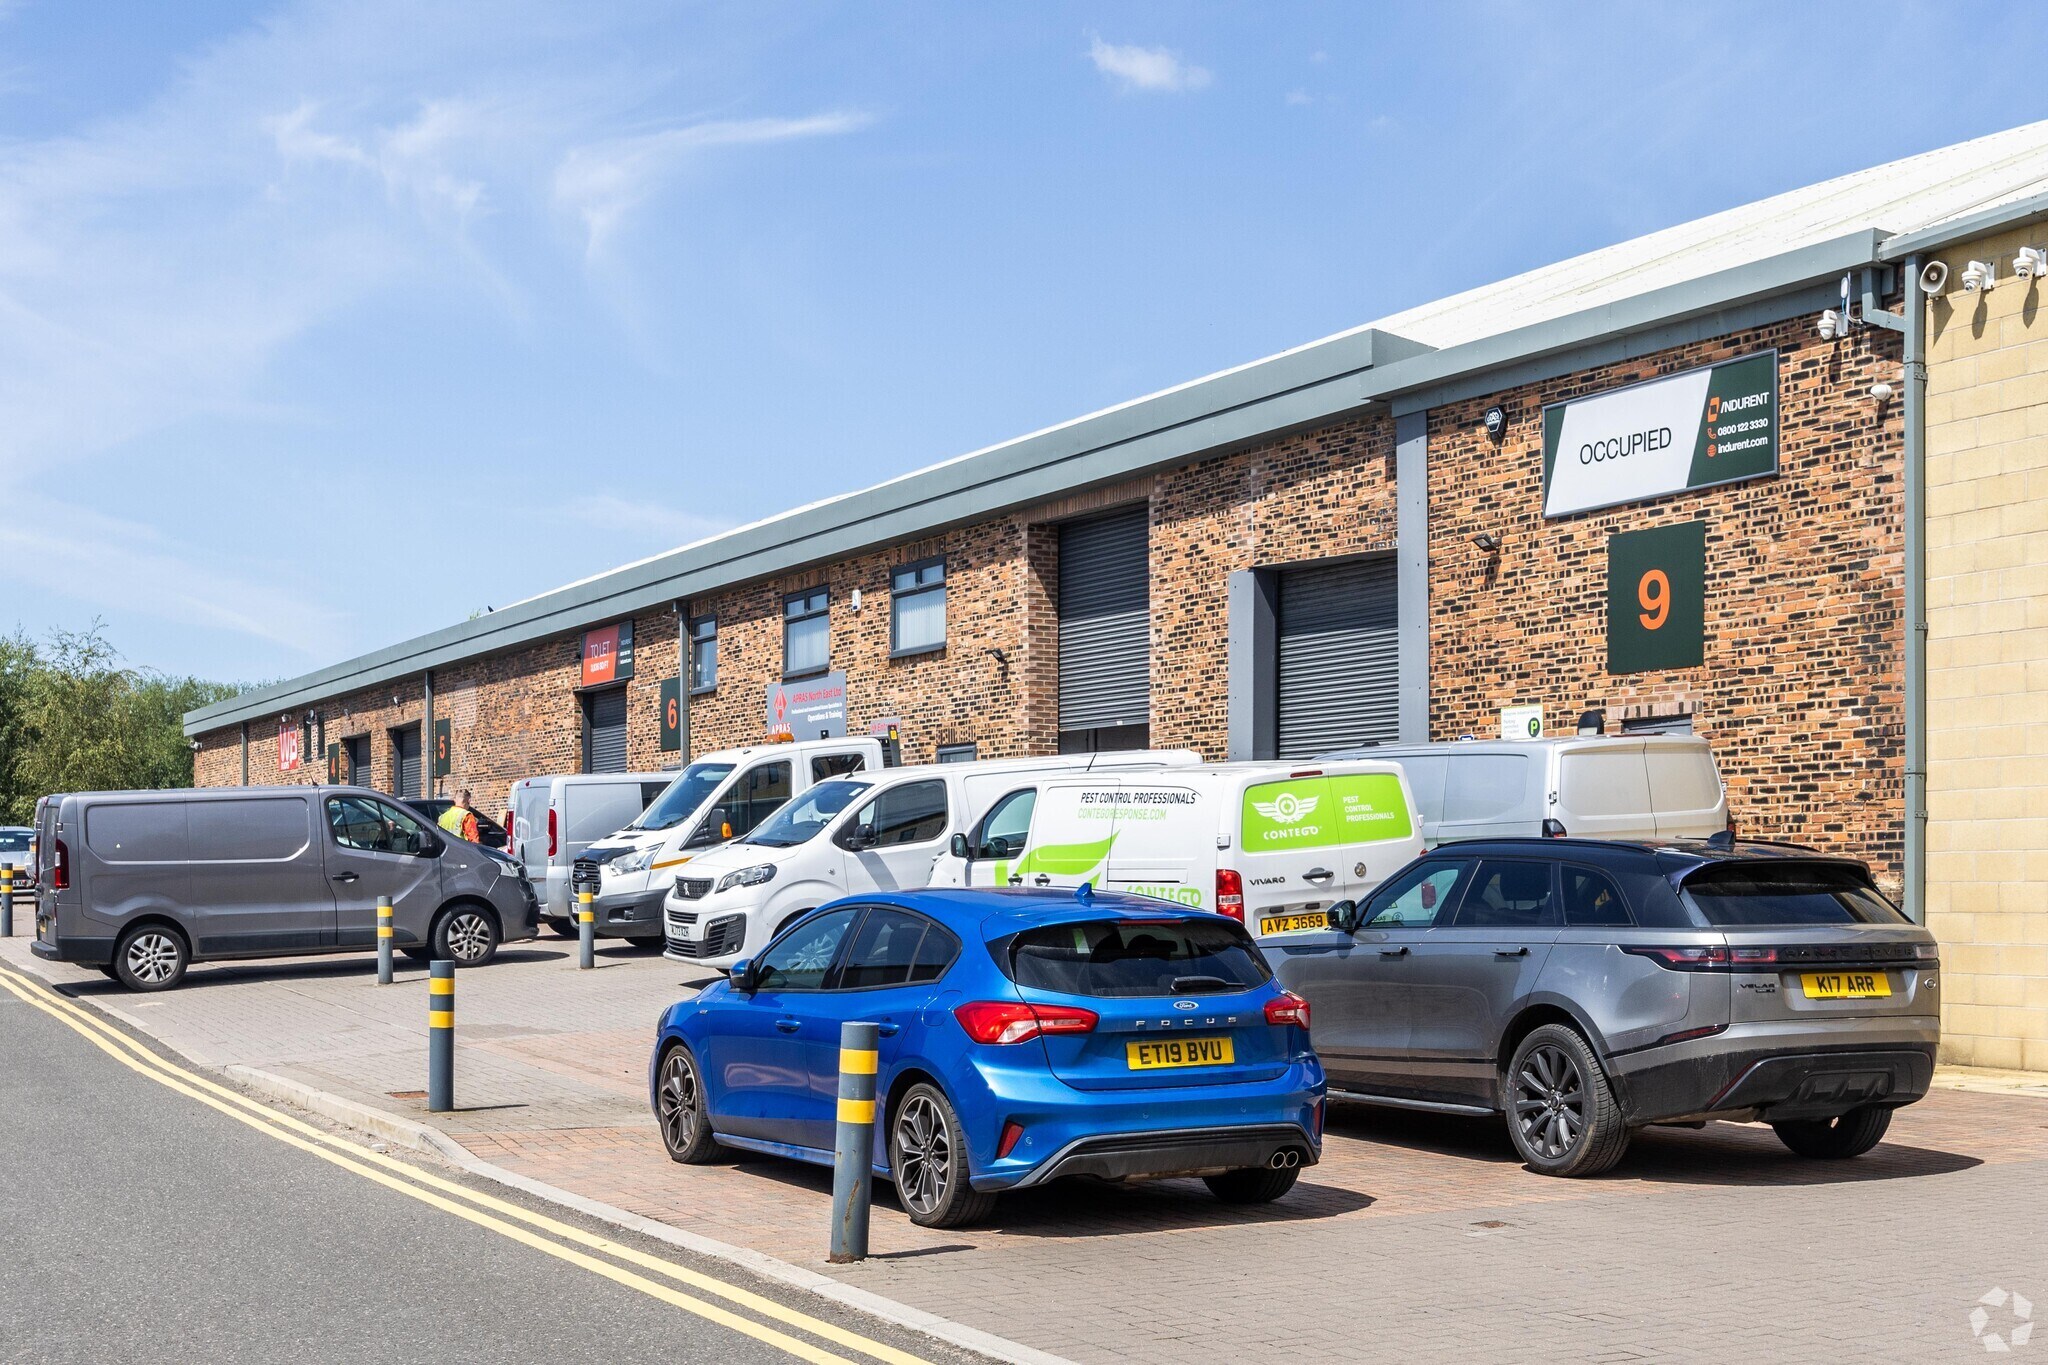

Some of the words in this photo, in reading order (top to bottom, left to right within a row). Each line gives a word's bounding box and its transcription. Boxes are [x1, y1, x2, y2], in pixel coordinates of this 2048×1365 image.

[1717, 424, 1737, 437] 0800
[1737, 421, 1749, 433] 122
[1749, 418, 1769, 430] 3330
[1579, 427, 1672, 465] OCCUPIED
[1717, 436, 1768, 454] indurent.com
[1638, 569, 1671, 631] 9
[590, 643, 599, 660] TO
[599, 640, 610, 658] LET
[792, 691, 808, 704] APRAS
[808, 689, 823, 702] North
[823, 687, 833, 699] East
[833, 686, 842, 698] Ltd
[667, 697, 678, 730] 6
[771, 722, 791, 735] APRAS
[439, 735, 446, 760] 5
[330, 756, 337, 778] 4
[1080, 792, 1099, 803] PEST
[1099, 792, 1132, 804] CONTROL
[1133, 792, 1197, 805] PROFESSIONALS
[1342, 795, 1359, 804] PEST
[1077, 807, 1167, 820] CONTEGORESPONSE.COM
[1344, 804, 1373, 813] CONTROL
[1346, 812, 1395, 822] PROFESSIONALS
[1263, 826, 1319, 840] CONTEGO
[1249, 876, 1286, 886] VIVARO
[1266, 918, 1289, 933] AVZ
[1292, 914, 1324, 930] 3669
[1816, 975, 1841, 993] K17
[1848, 975, 1876, 993] ARR
[1135, 1016, 1237, 1027] FOCUS
[1138, 1043, 1182, 1065] ET19
[1186, 1040, 1223, 1062] BVU
